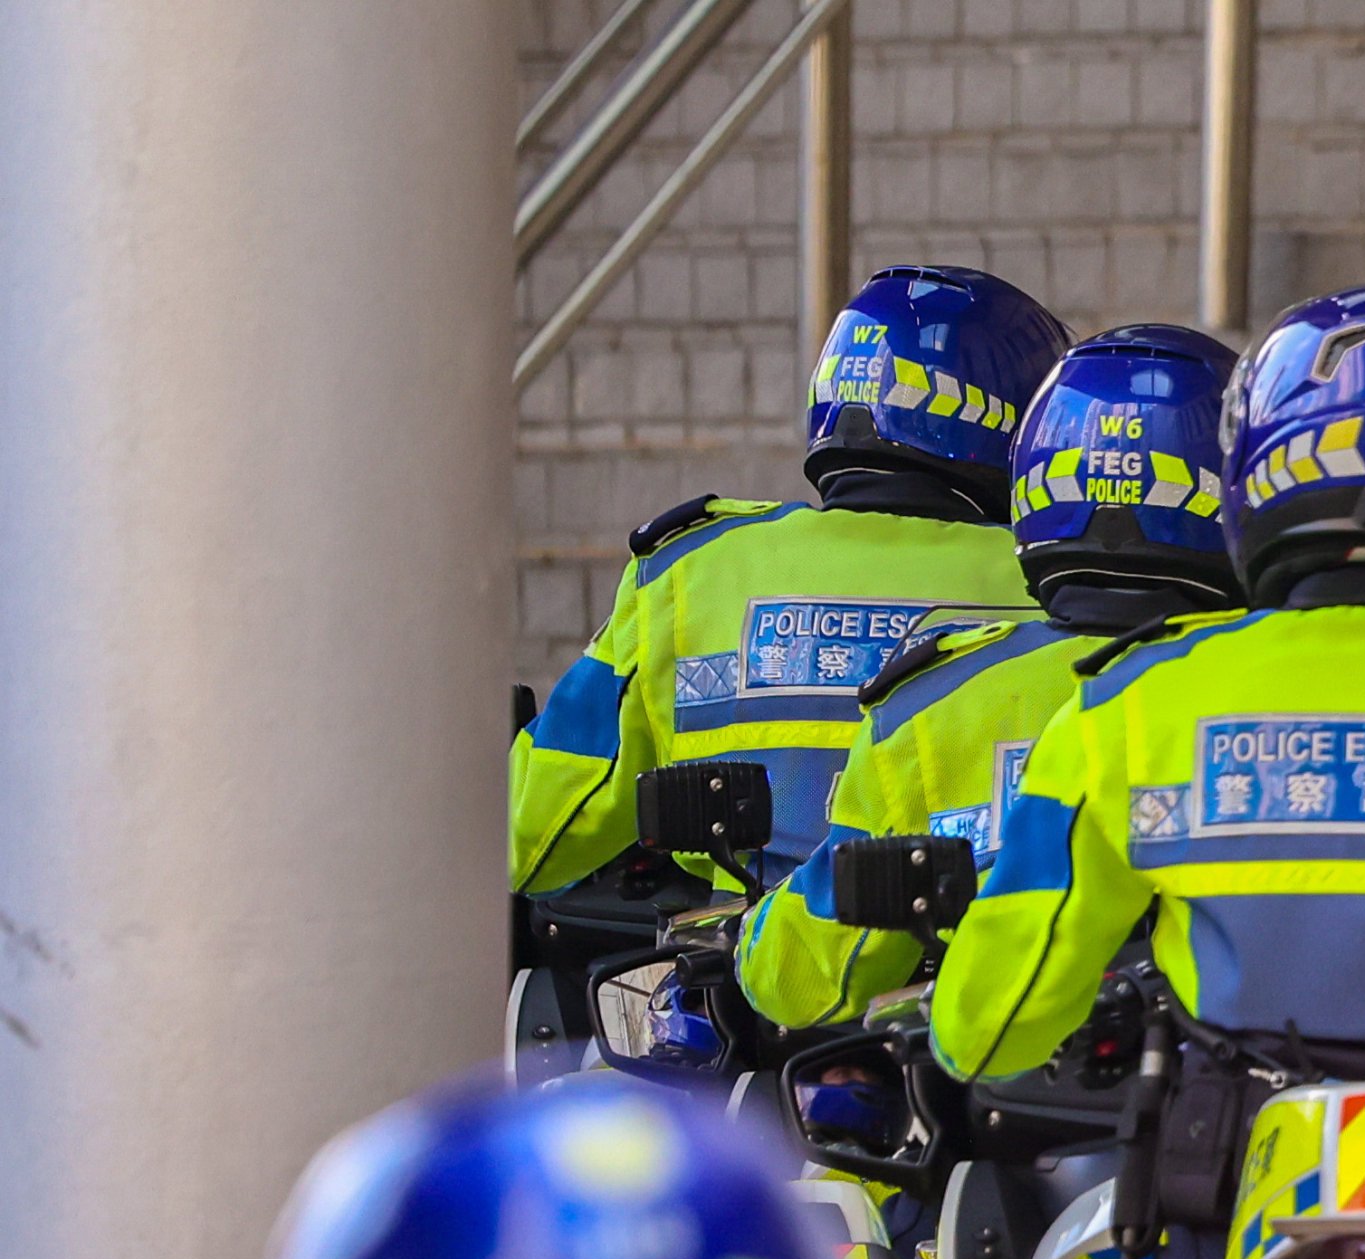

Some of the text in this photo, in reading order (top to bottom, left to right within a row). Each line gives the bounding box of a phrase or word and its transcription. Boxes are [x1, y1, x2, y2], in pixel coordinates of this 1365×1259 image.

[853, 325, 889, 344] W7
[840, 356, 883, 378] FEG
[837, 380, 881, 404] POLICE
[1100, 415, 1143, 439] W6
[1088, 450, 1143, 476] FEG
[1086, 477, 1143, 505] POLICE
[757, 610, 859, 638] POLICE
[1212, 730, 1335, 764] POLICE
